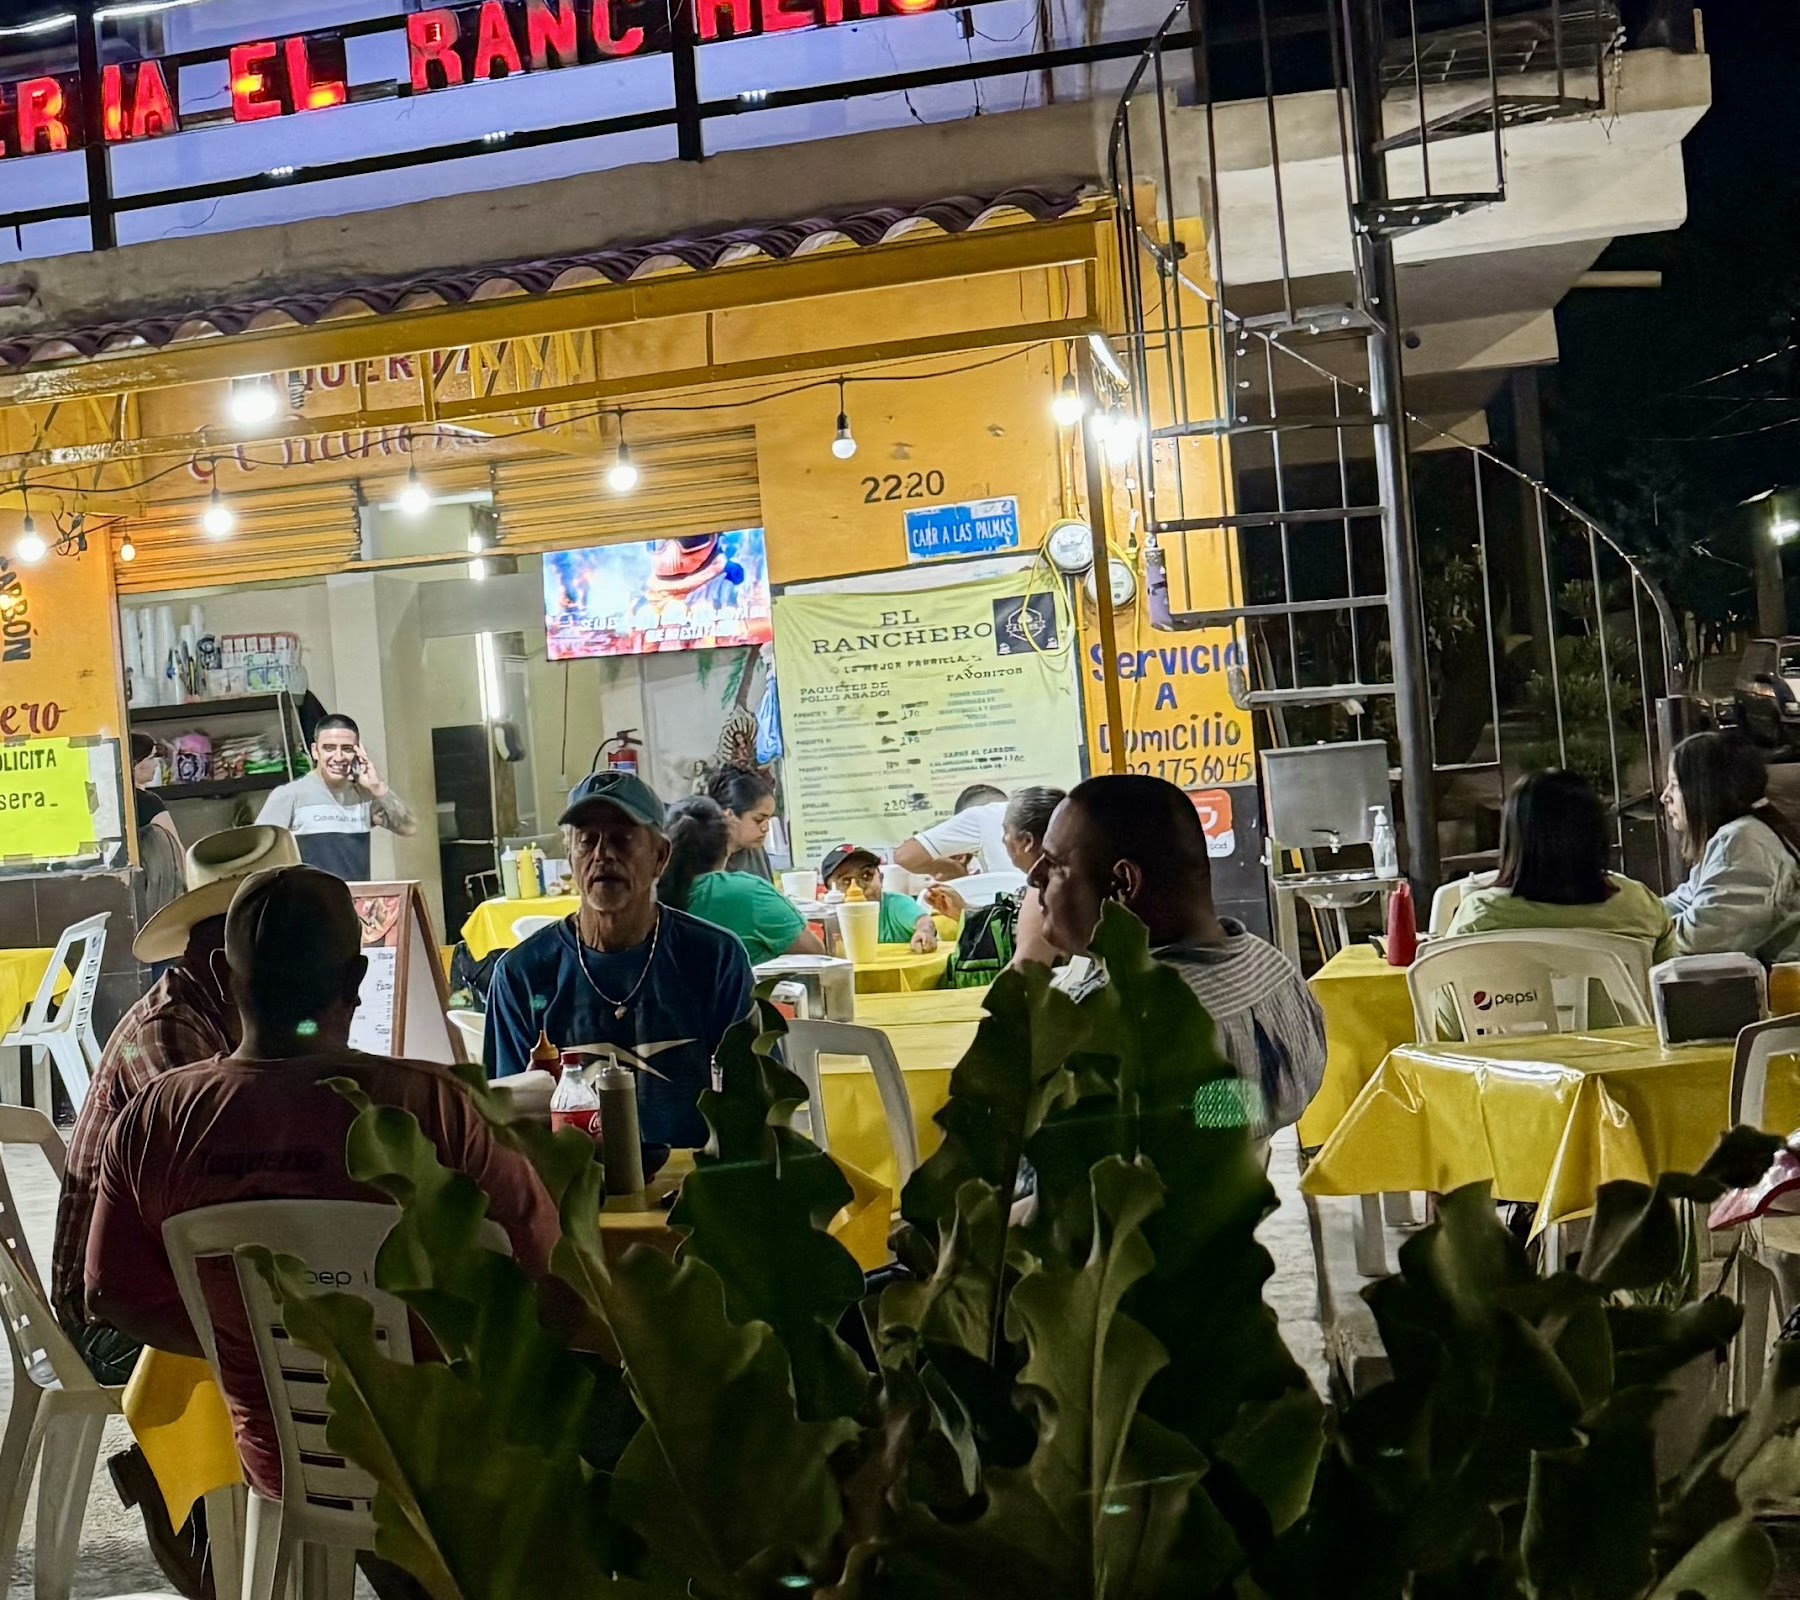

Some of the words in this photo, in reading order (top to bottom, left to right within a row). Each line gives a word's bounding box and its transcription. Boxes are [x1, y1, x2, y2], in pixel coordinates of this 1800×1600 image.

[229, 35, 347, 123] EL
[860, 469, 945, 504] 2220
[952, 522, 972, 543] LAS
[975, 517, 1014, 540] PALMAS
[879, 609, 920, 627] EL
[811, 622, 993, 655] RANCHERO
[1154, 681, 1178, 711] A
[1494, 988, 1538, 1007] pepsi
[303, 1269, 369, 1288] pepi
